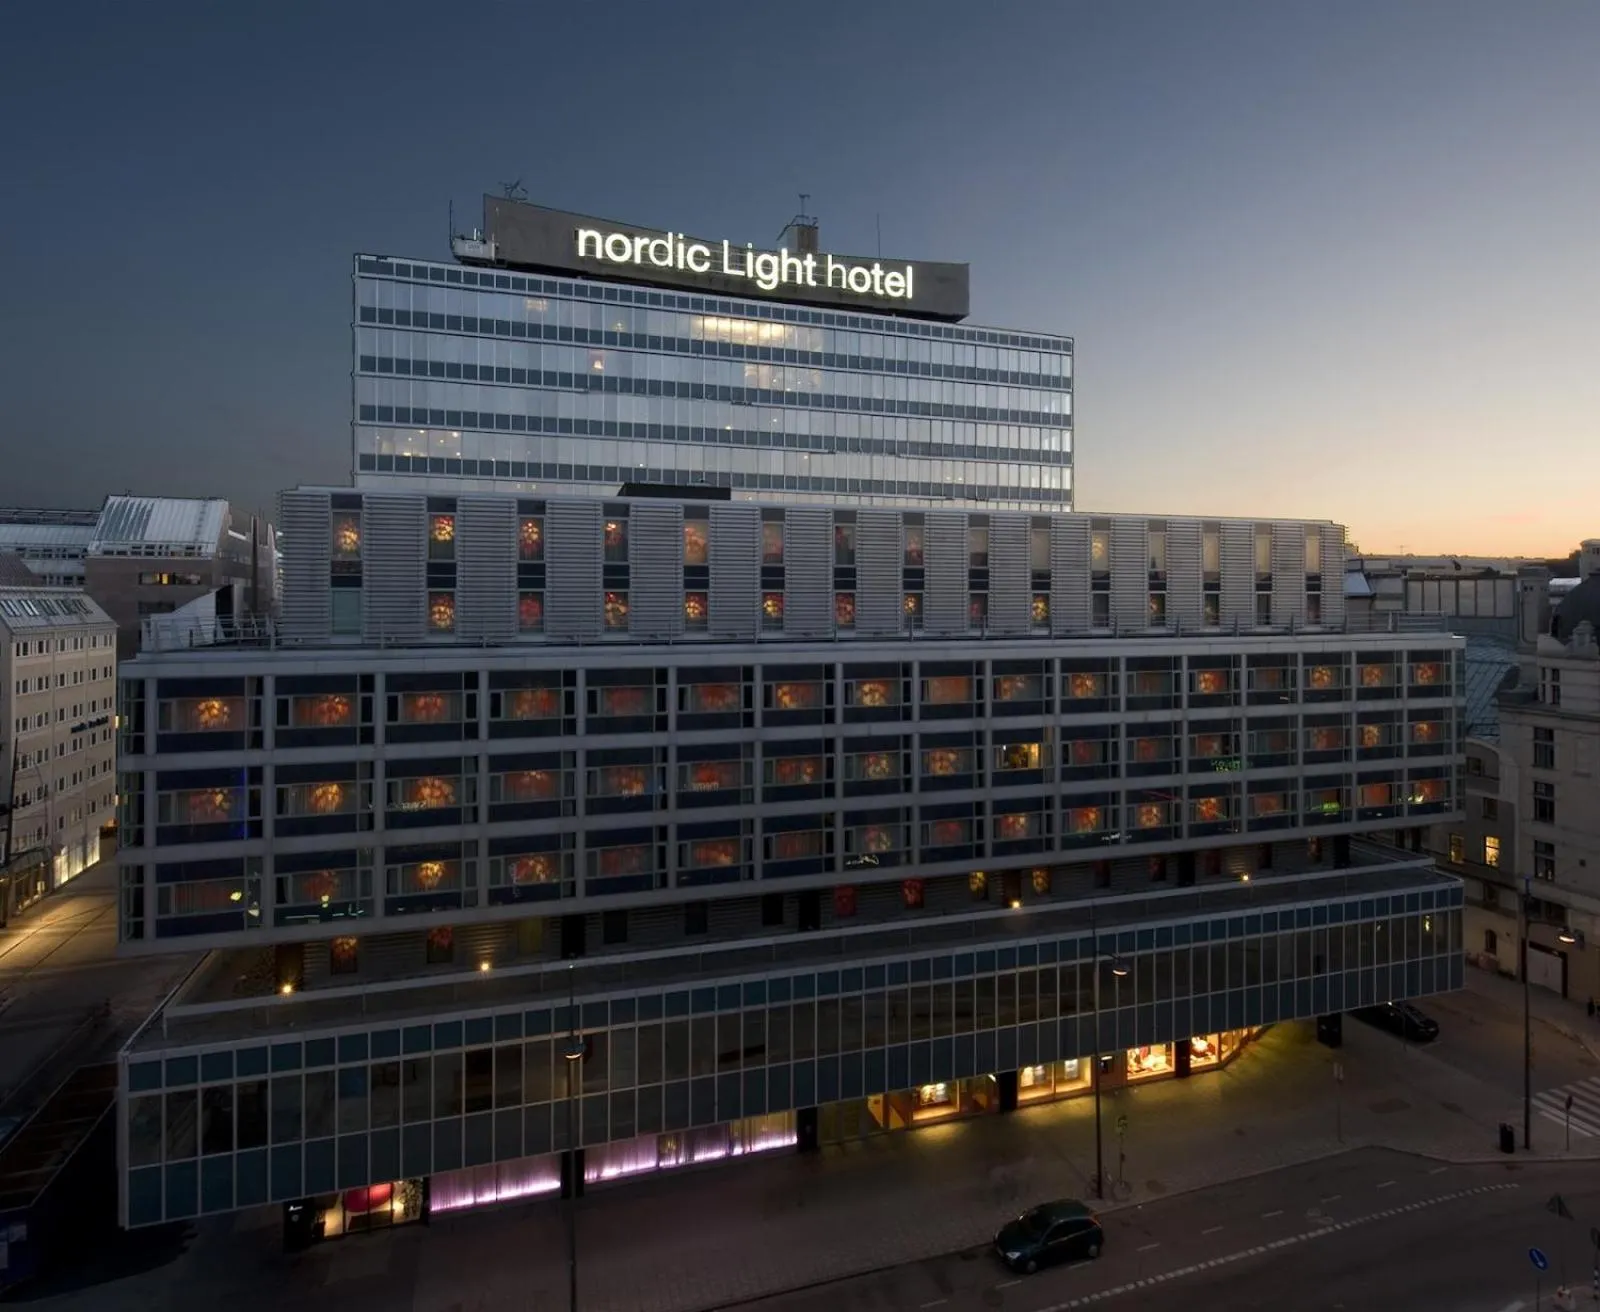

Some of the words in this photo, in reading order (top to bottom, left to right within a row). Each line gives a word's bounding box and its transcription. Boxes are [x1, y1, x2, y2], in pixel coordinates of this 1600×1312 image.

[577, 228, 711, 273] nordic
[722, 239, 817, 291] Light
[827, 254, 914, 299] hotel
